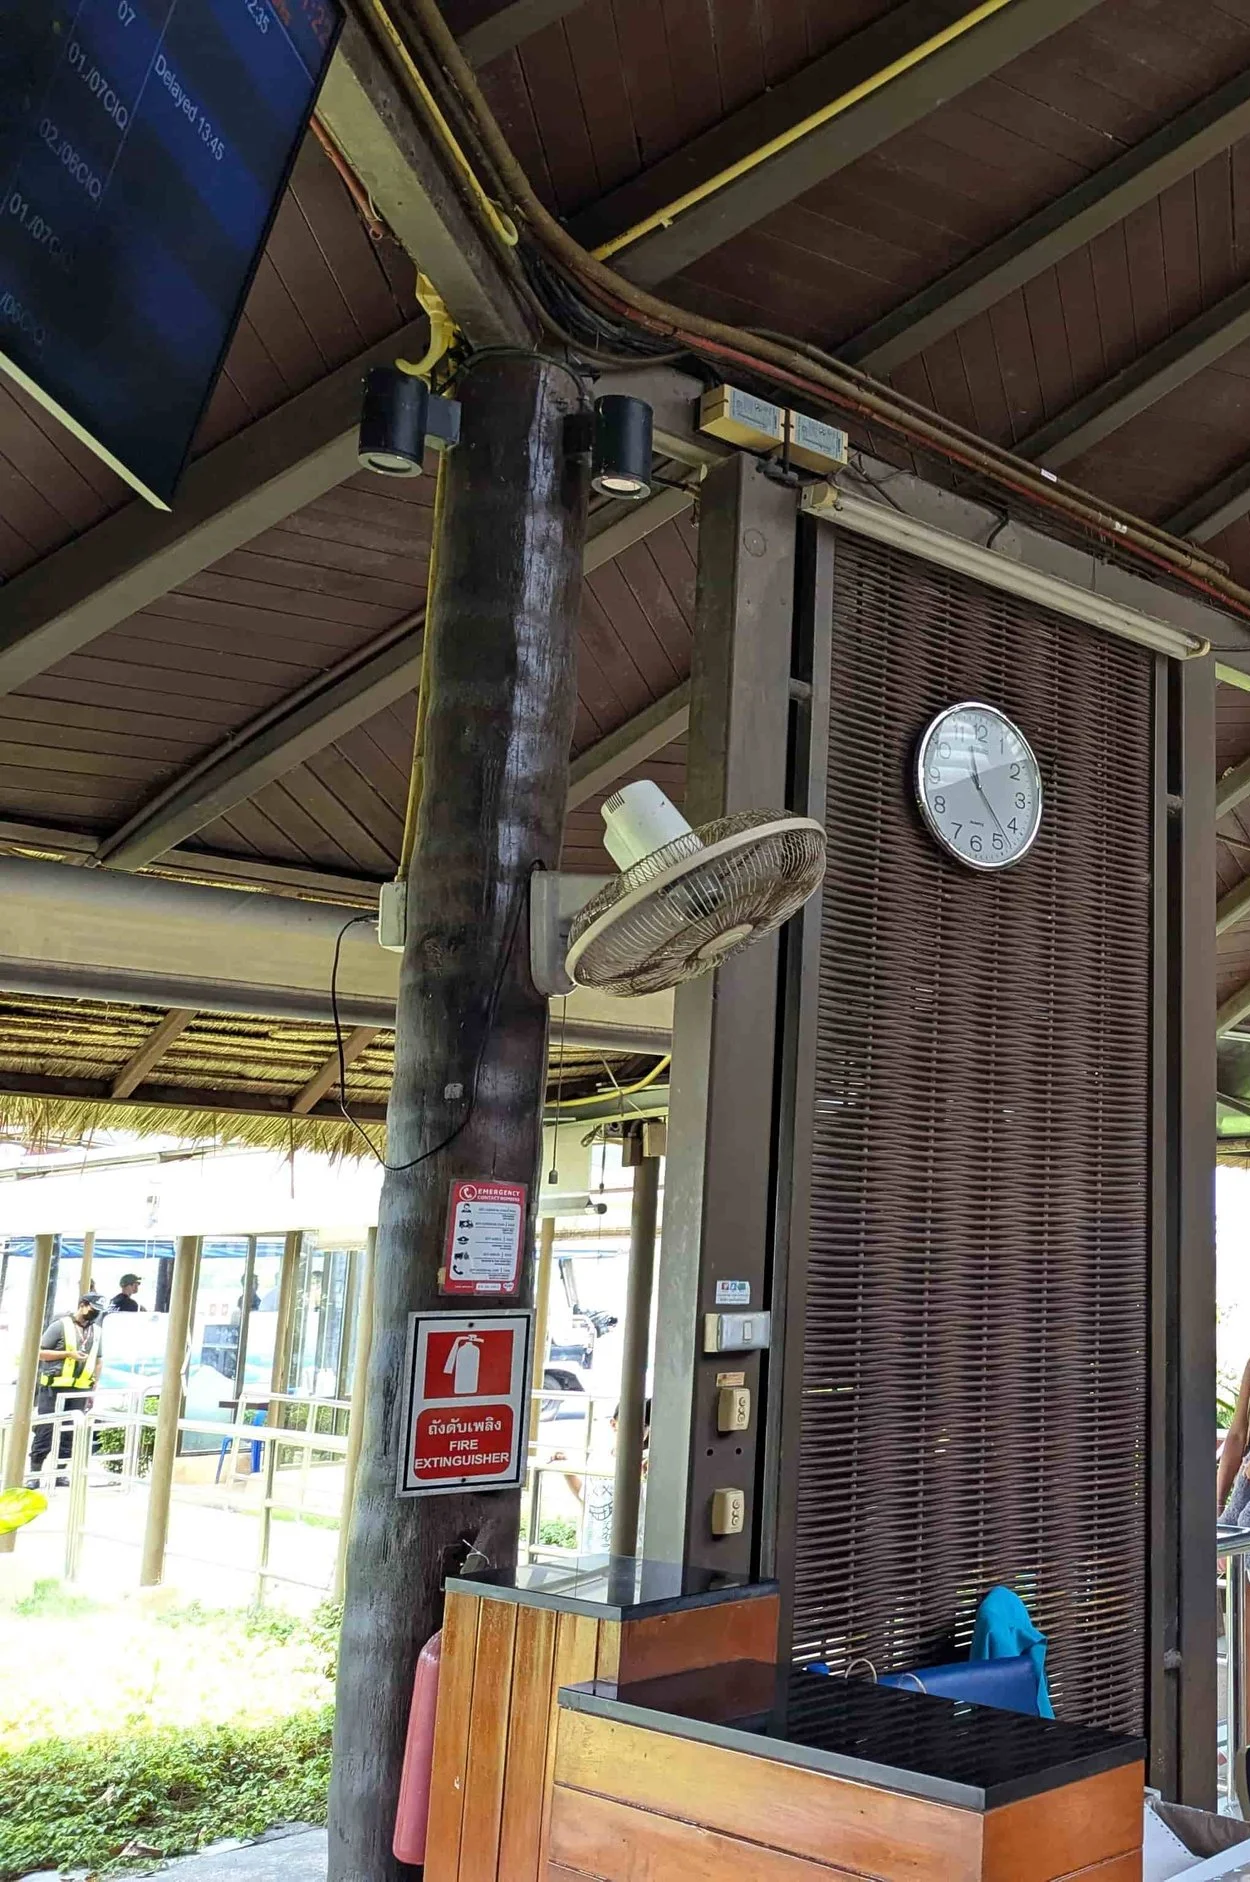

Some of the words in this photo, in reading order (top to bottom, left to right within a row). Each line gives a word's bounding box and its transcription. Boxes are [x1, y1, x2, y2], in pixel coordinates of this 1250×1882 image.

[154, 54, 198, 123] Delayed
[197, 117, 225, 162] 13:45
[974, 724, 988, 743] 12
[930, 767, 940, 784] 9
[1010, 763, 1021, 781] 2
[934, 795, 946, 814] 8
[1014, 792, 1026, 809] 3
[951, 822, 962, 839] 7
[1007, 817, 1018, 834] 4
[970, 835, 982, 852] 6
[992, 833, 1003, 850] 5
[477, 1188, 520, 1196] EMERGENCY
[428, 1416, 502, 1436] ถังดับเพลิง
[449, 1439, 479, 1451] FIRE
[414, 1452, 510, 1470] EXTINGUISHER
